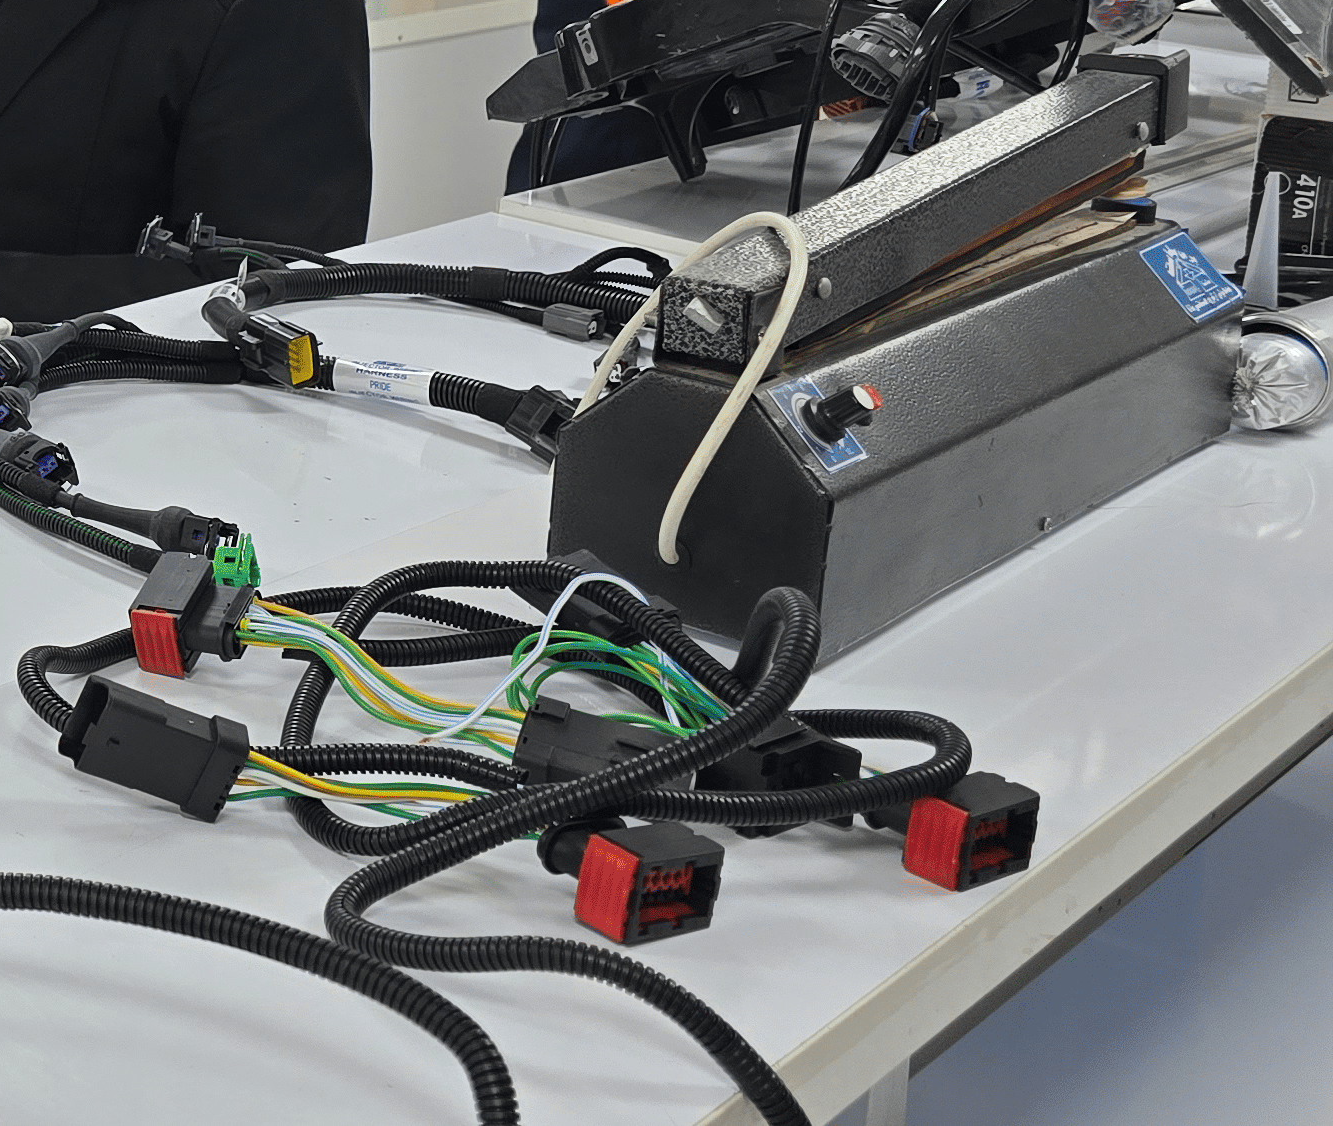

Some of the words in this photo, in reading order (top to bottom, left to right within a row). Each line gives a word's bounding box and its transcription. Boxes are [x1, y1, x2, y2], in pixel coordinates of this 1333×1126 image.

[1292, 174, 1317, 219] 410A
[356, 368, 408, 380] HARNESS
[369, 380, 392, 392] PRIDE
